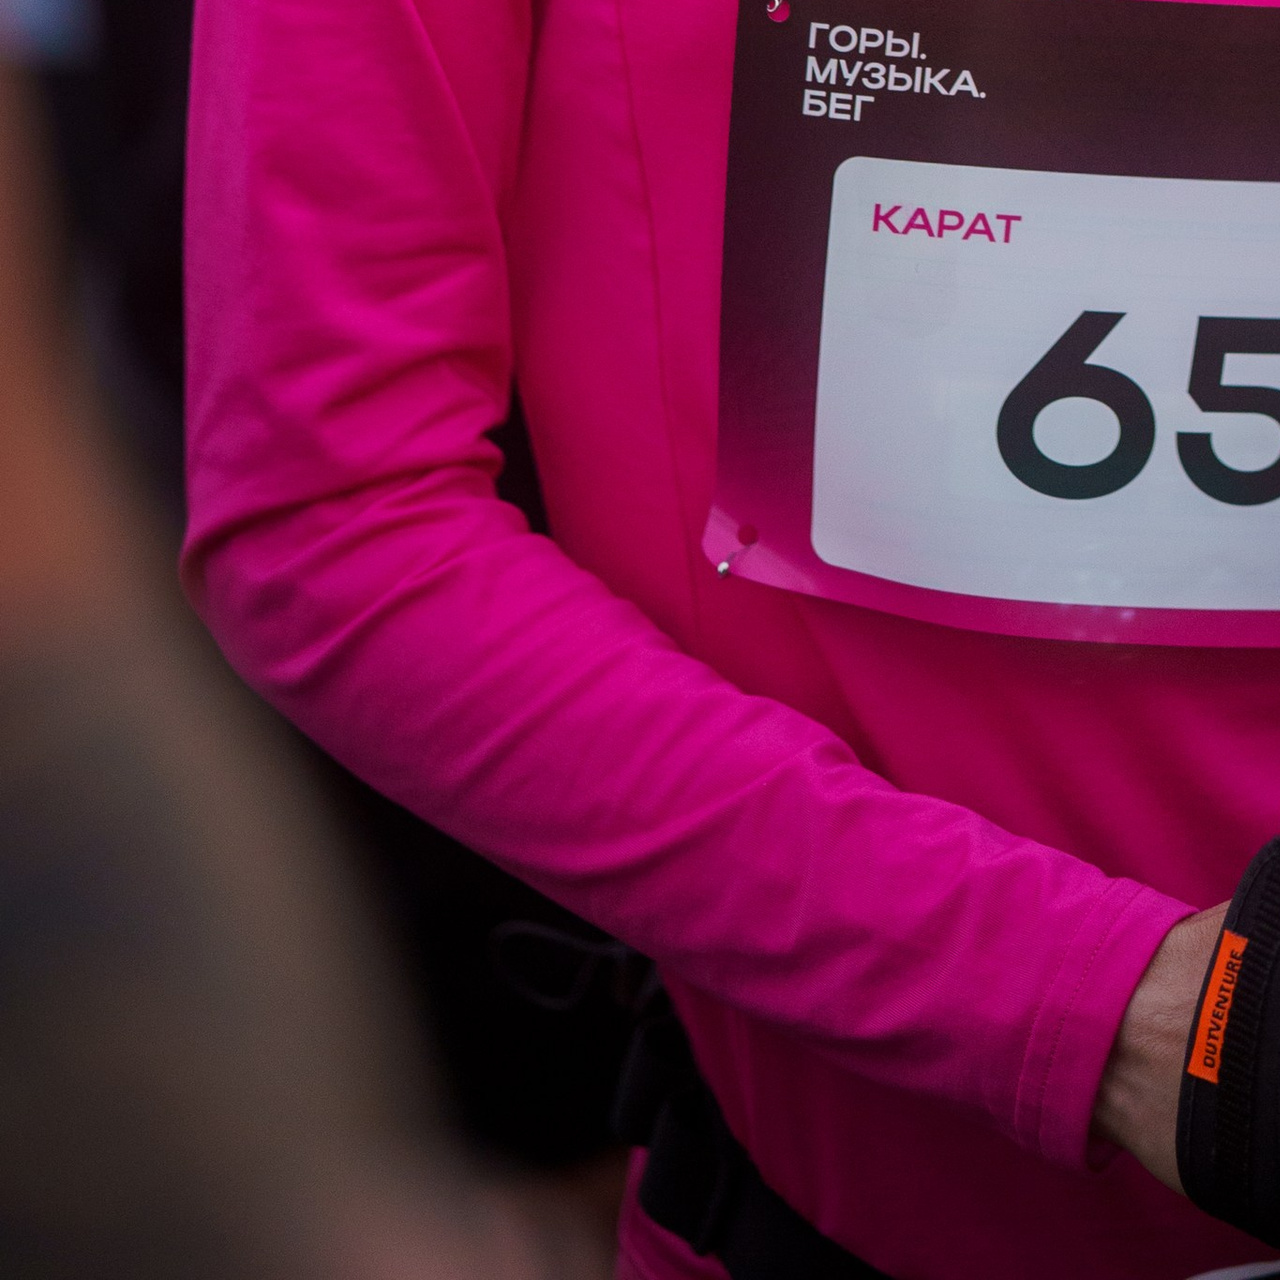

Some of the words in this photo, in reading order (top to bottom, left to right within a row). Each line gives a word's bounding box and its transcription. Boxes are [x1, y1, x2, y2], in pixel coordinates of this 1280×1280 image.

[807, 21, 927, 60] ГОРЫ.
[804, 55, 987, 99] МУЗЫКА.
[802, 88, 875, 122] БЕГ
[872, 203, 1022, 244] КАРАТ
[1203, 949, 1243, 1069] OUTVENTURE
